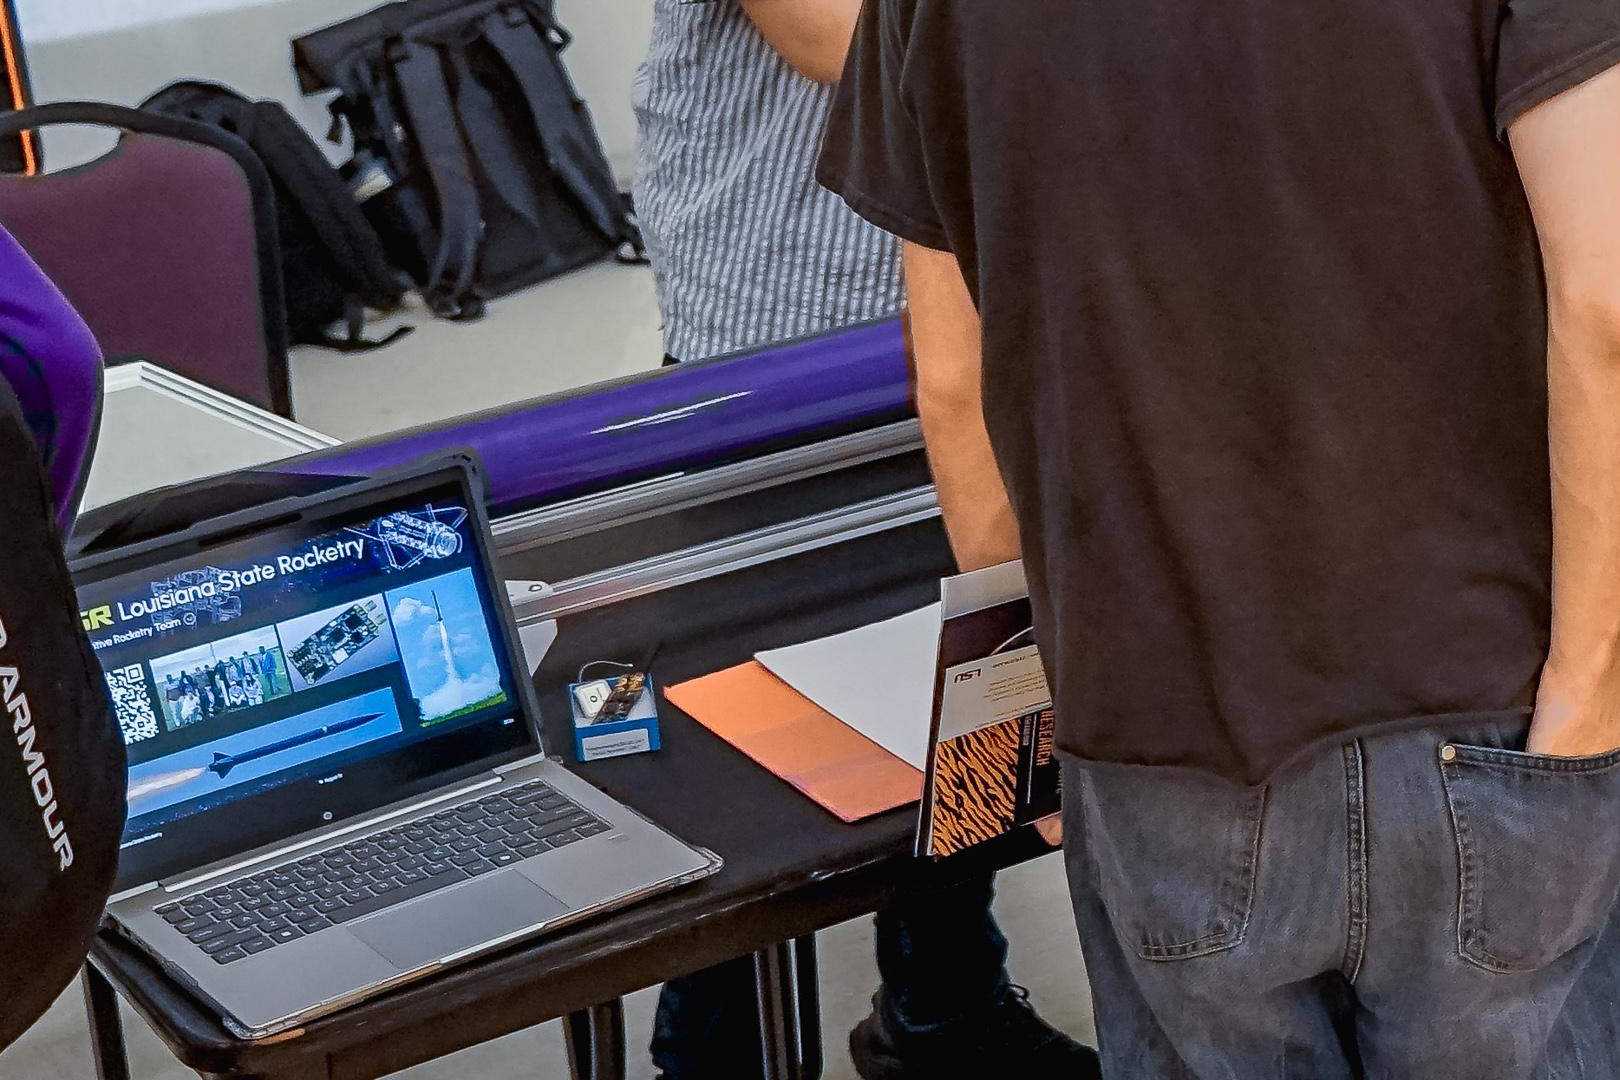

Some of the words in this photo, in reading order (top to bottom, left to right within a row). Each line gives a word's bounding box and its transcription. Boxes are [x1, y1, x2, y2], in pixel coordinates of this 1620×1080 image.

[116, 581, 216, 621] Louisiana
[218, 563, 276, 592] State
[277, 537, 365, 576] Rocketry
[113, 625, 153, 645] Rocketry
[153, 618, 182, 632] Team
[0, 666, 74, 872] ARMOUR
